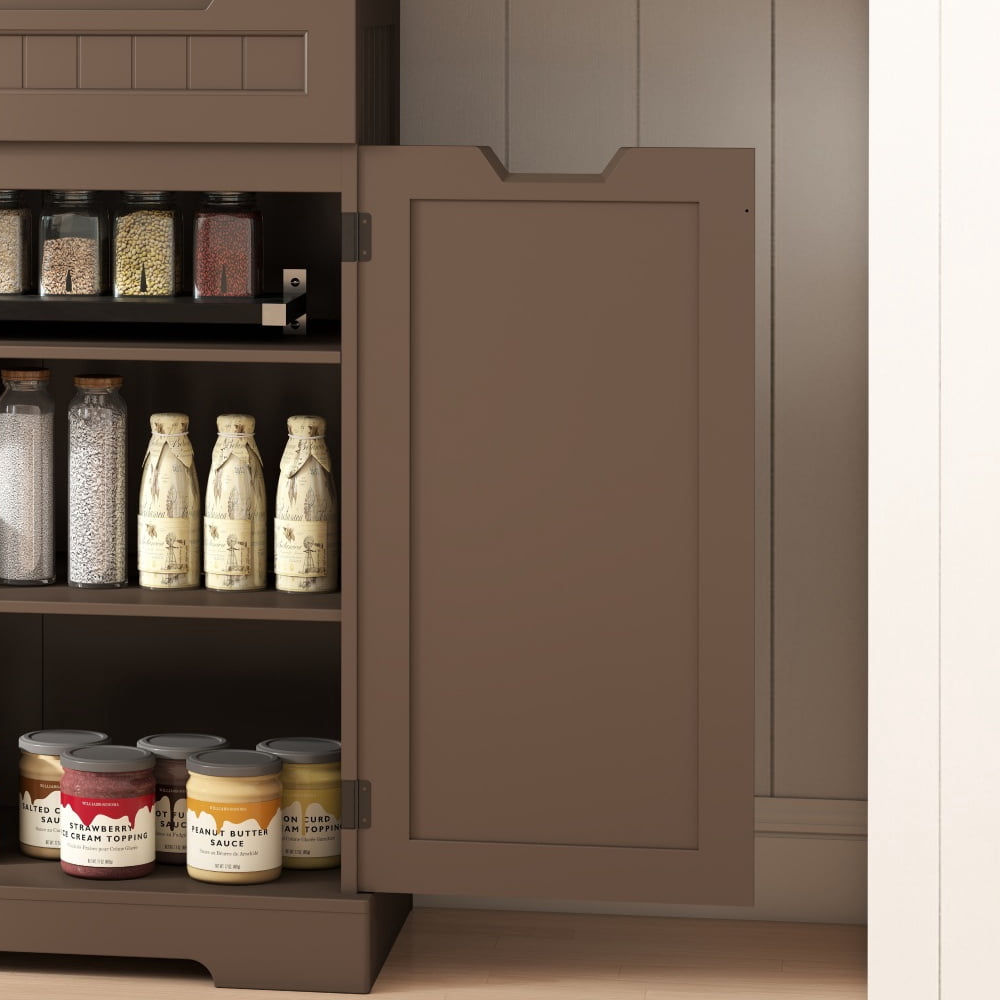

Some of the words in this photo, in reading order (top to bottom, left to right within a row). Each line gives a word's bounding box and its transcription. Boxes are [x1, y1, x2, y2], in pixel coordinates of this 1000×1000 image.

[69, 822, 132, 833] STRAWBERRY
[191, 825, 225, 837] PEANUT
[230, 828, 268, 837] BUTTER
[70, 832, 102, 843] CREAM
[106, 832, 148, 843] TOPPING
[210, 839, 244, 848] SAUCE
